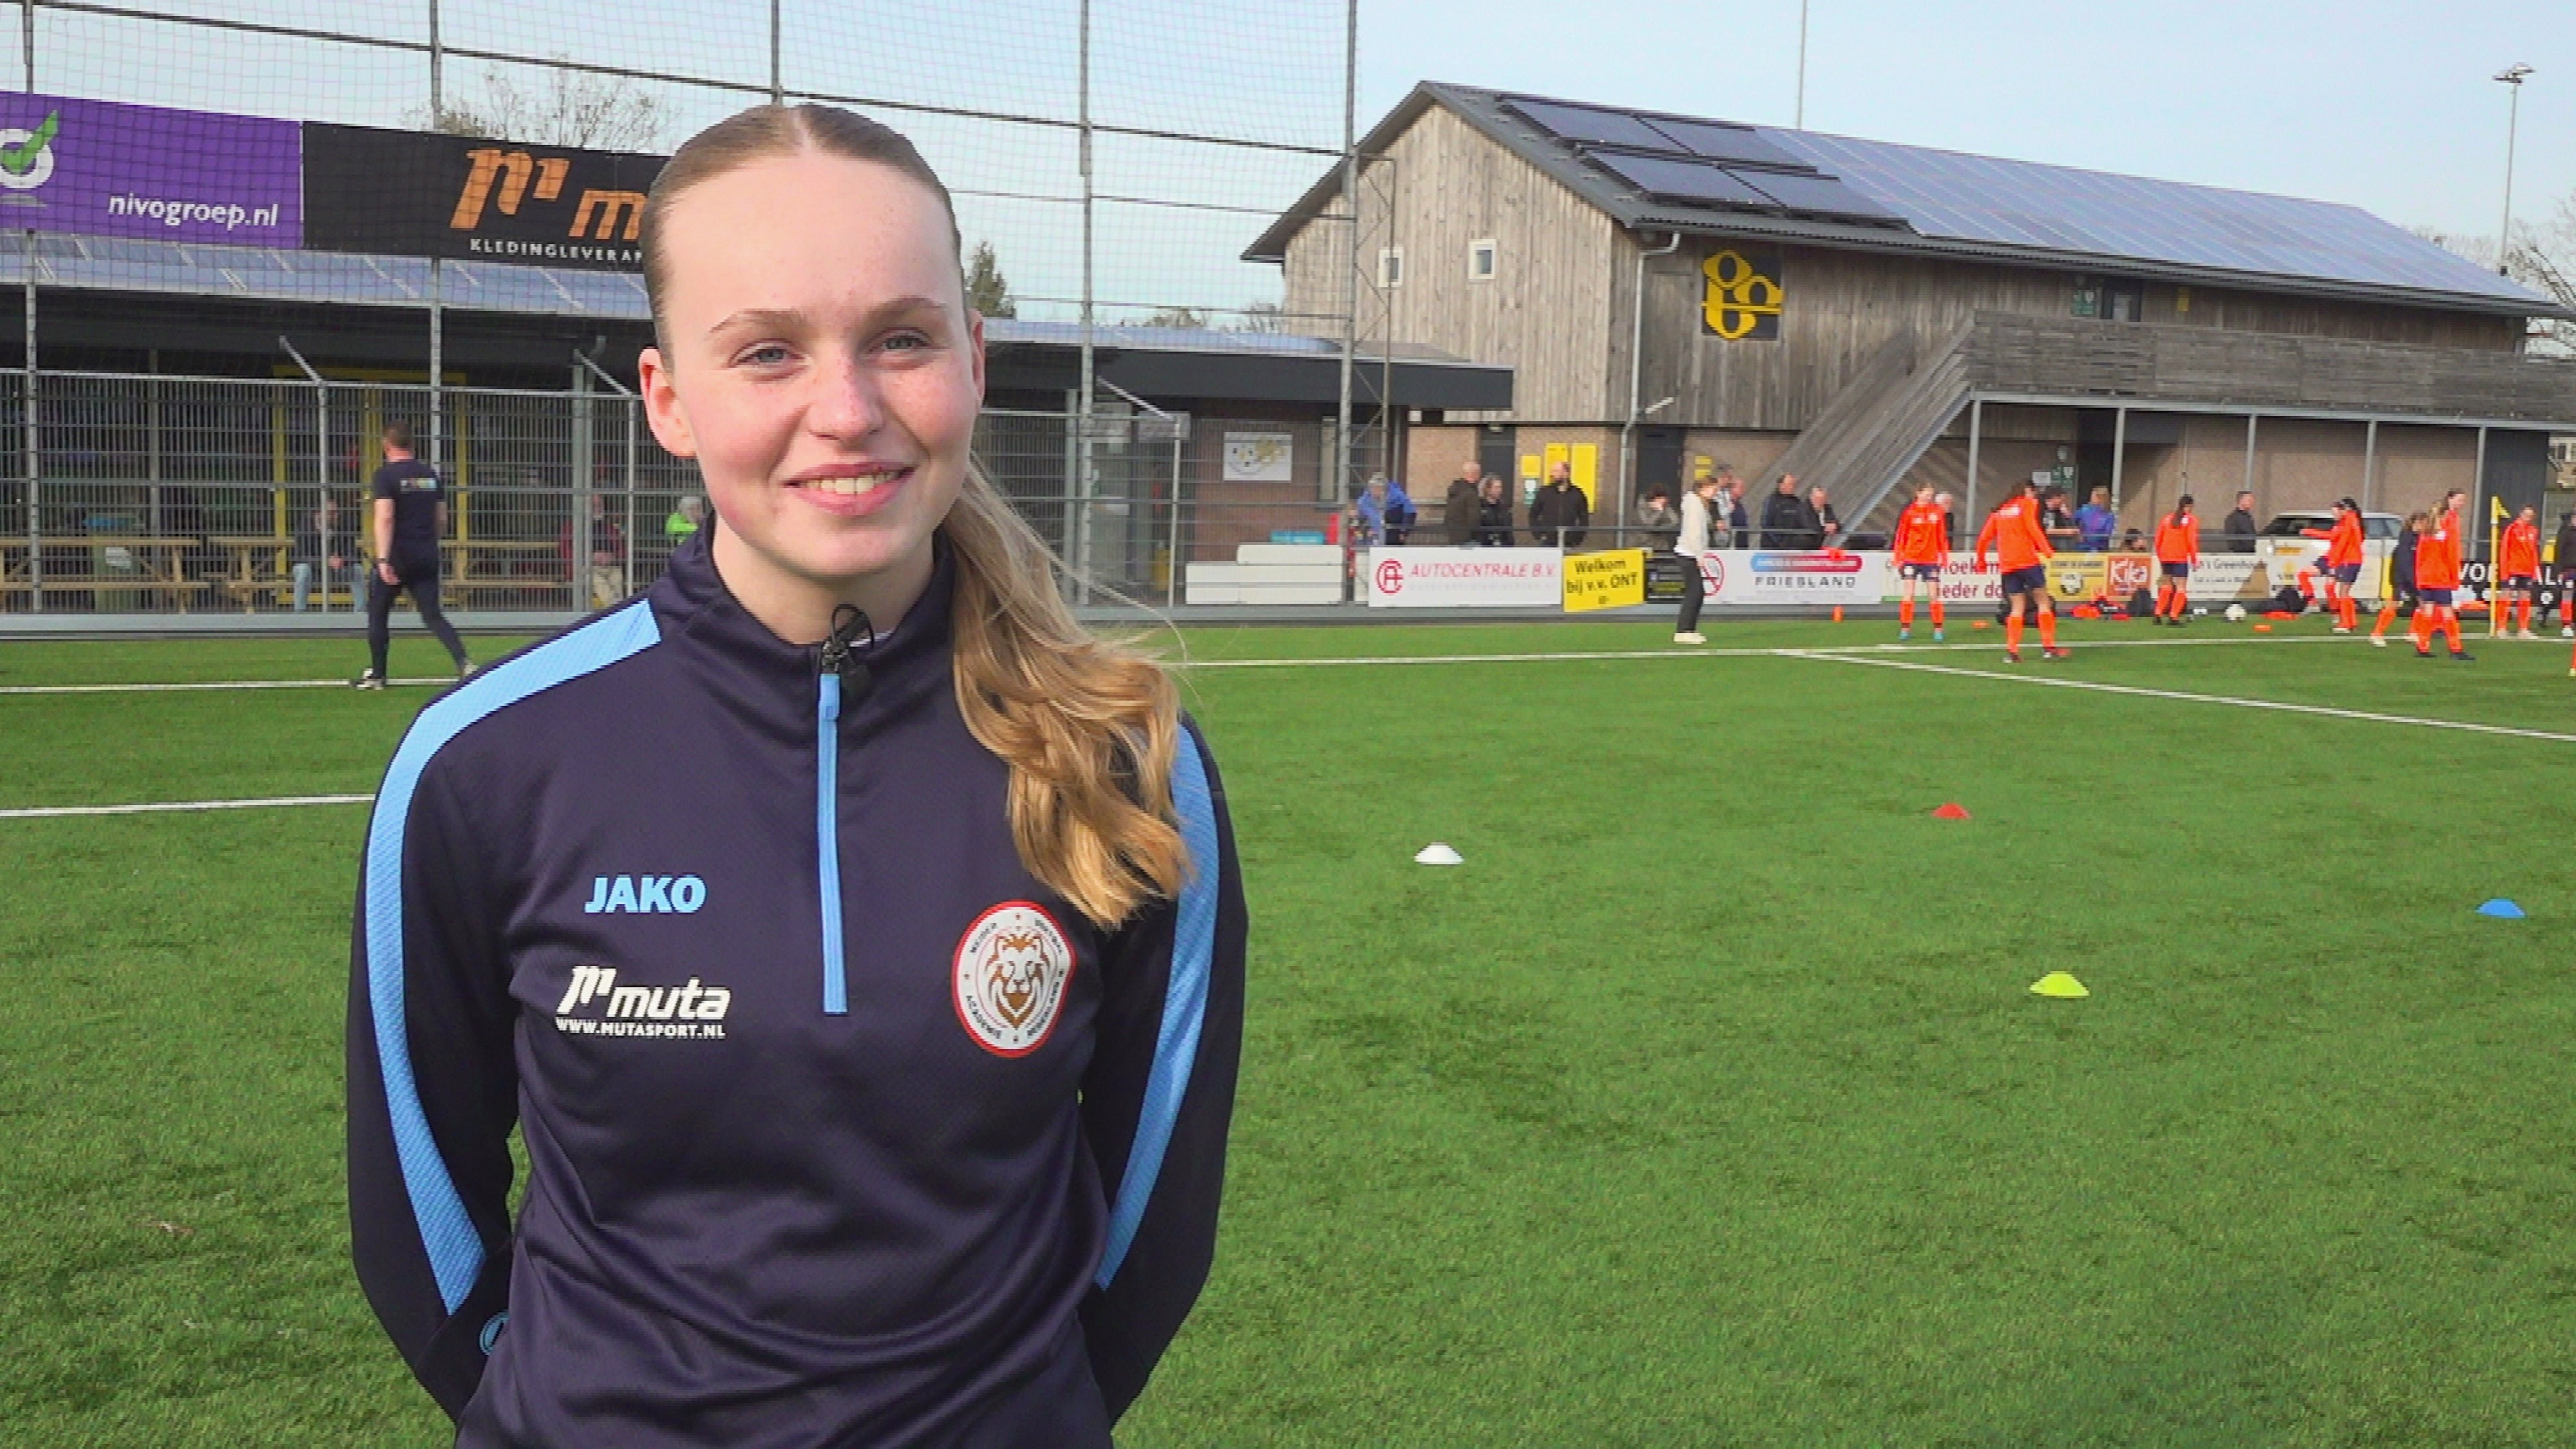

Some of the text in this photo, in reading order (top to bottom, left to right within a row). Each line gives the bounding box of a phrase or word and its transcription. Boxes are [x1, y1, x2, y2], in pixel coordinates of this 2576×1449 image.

[108, 193, 278, 231] nivogroep.nl
[1410, 563, 1528, 577] AUTOCENTRALE
[1575, 558, 1626, 574] Welkom
[1566, 578, 1583, 596] bij
[1610, 572, 1637, 588] ONT
[1755, 576, 1855, 588] FRIESLAND
[585, 875, 706, 913] JAKO
[606, 976, 731, 1020] muta
[555, 1017, 726, 1038] WWW.MUTASPORT.NL
